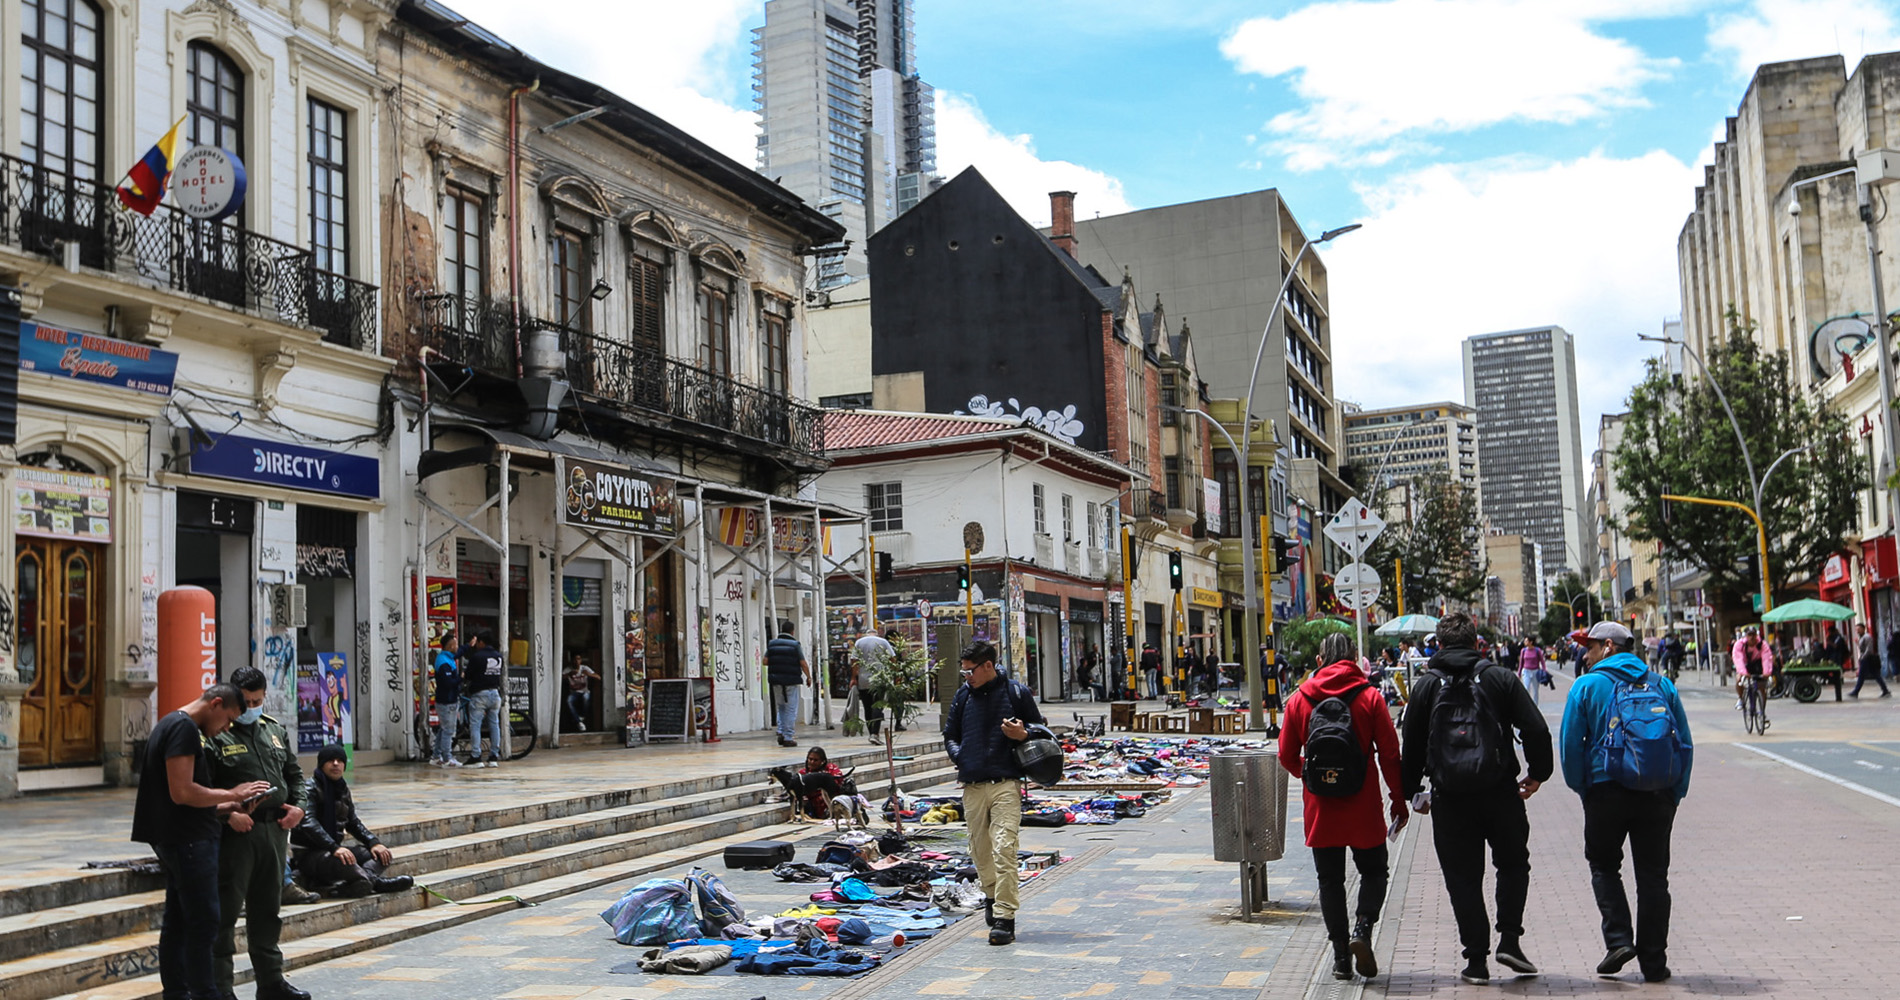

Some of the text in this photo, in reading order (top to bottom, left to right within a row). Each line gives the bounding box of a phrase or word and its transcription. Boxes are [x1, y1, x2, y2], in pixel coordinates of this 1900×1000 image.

[182, 175, 225, 188] HOTEL
[199, 158, 207, 205] HOTEL
[35, 325, 151, 361] HOTEL RESTAURANTE
[59, 347, 119, 378] España
[253, 448, 326, 480] DIRECTV
[596, 471, 648, 509] COYOTE
[602, 506, 643, 520] PARRILLA
